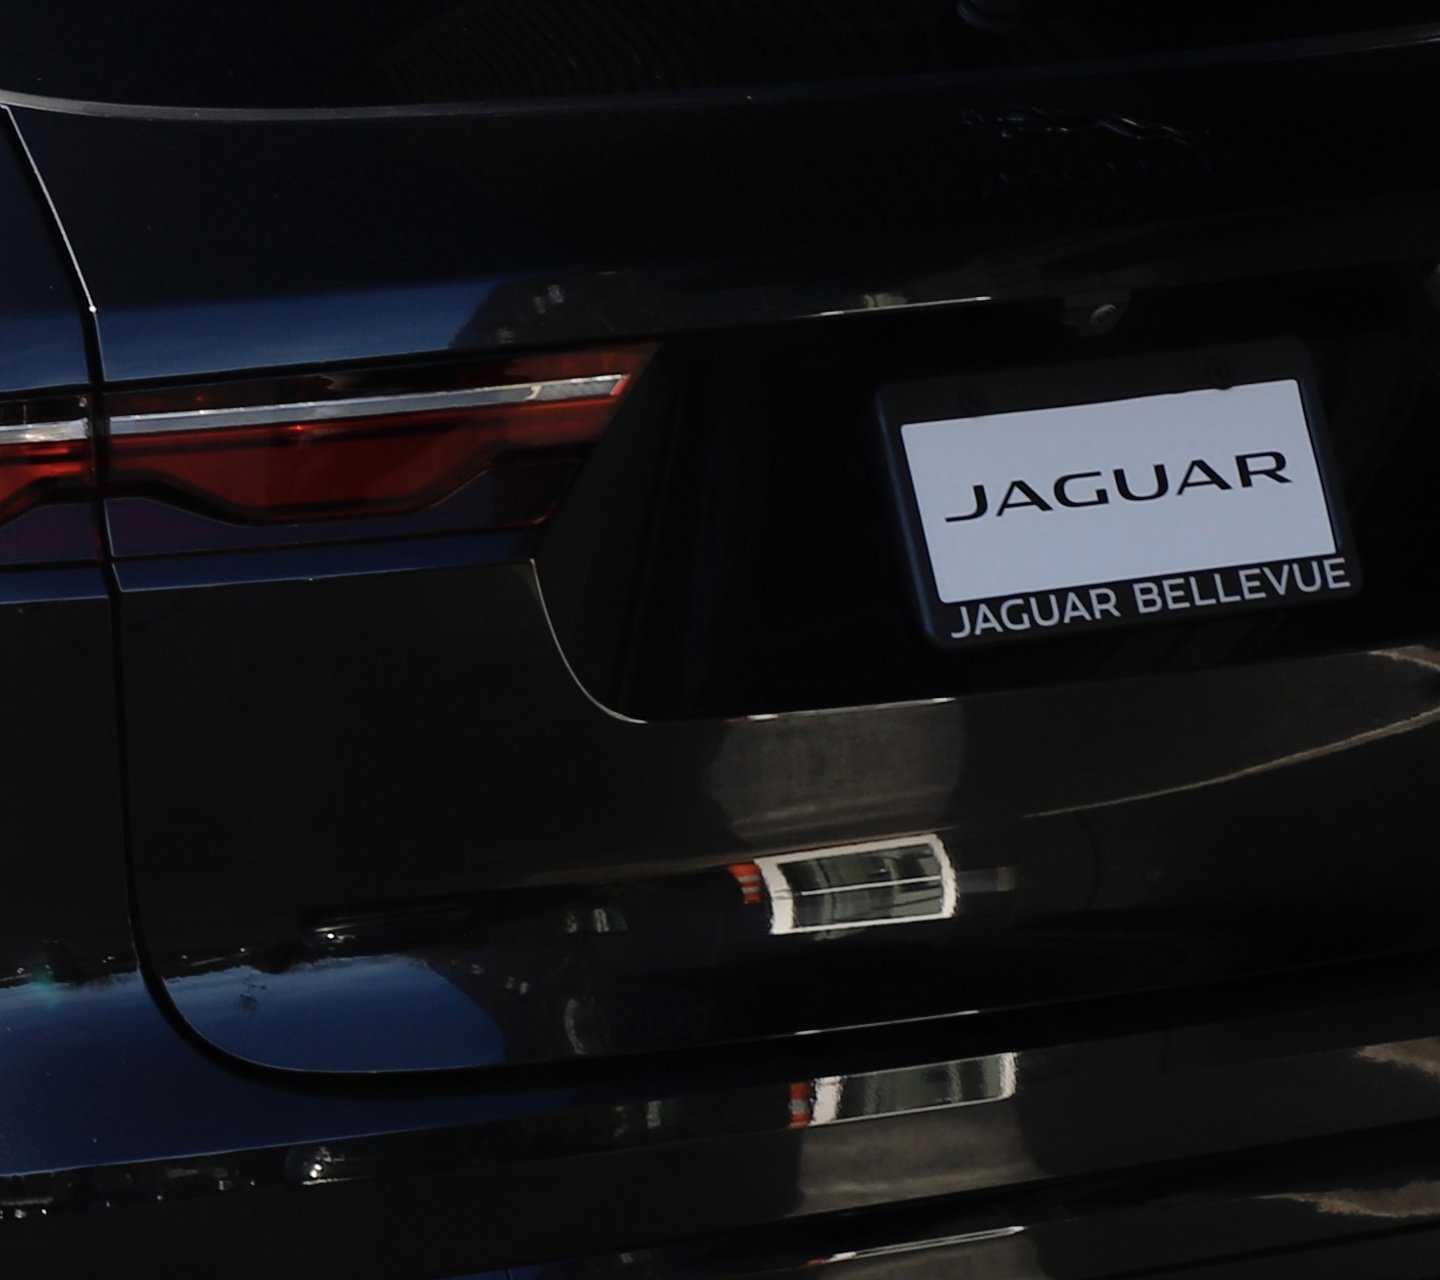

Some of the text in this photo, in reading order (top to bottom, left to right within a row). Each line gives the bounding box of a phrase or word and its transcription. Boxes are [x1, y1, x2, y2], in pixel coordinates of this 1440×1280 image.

[944, 450, 1292, 523] JAGUAR
[951, 557, 1351, 639] JAGUAR BELLEVUE
